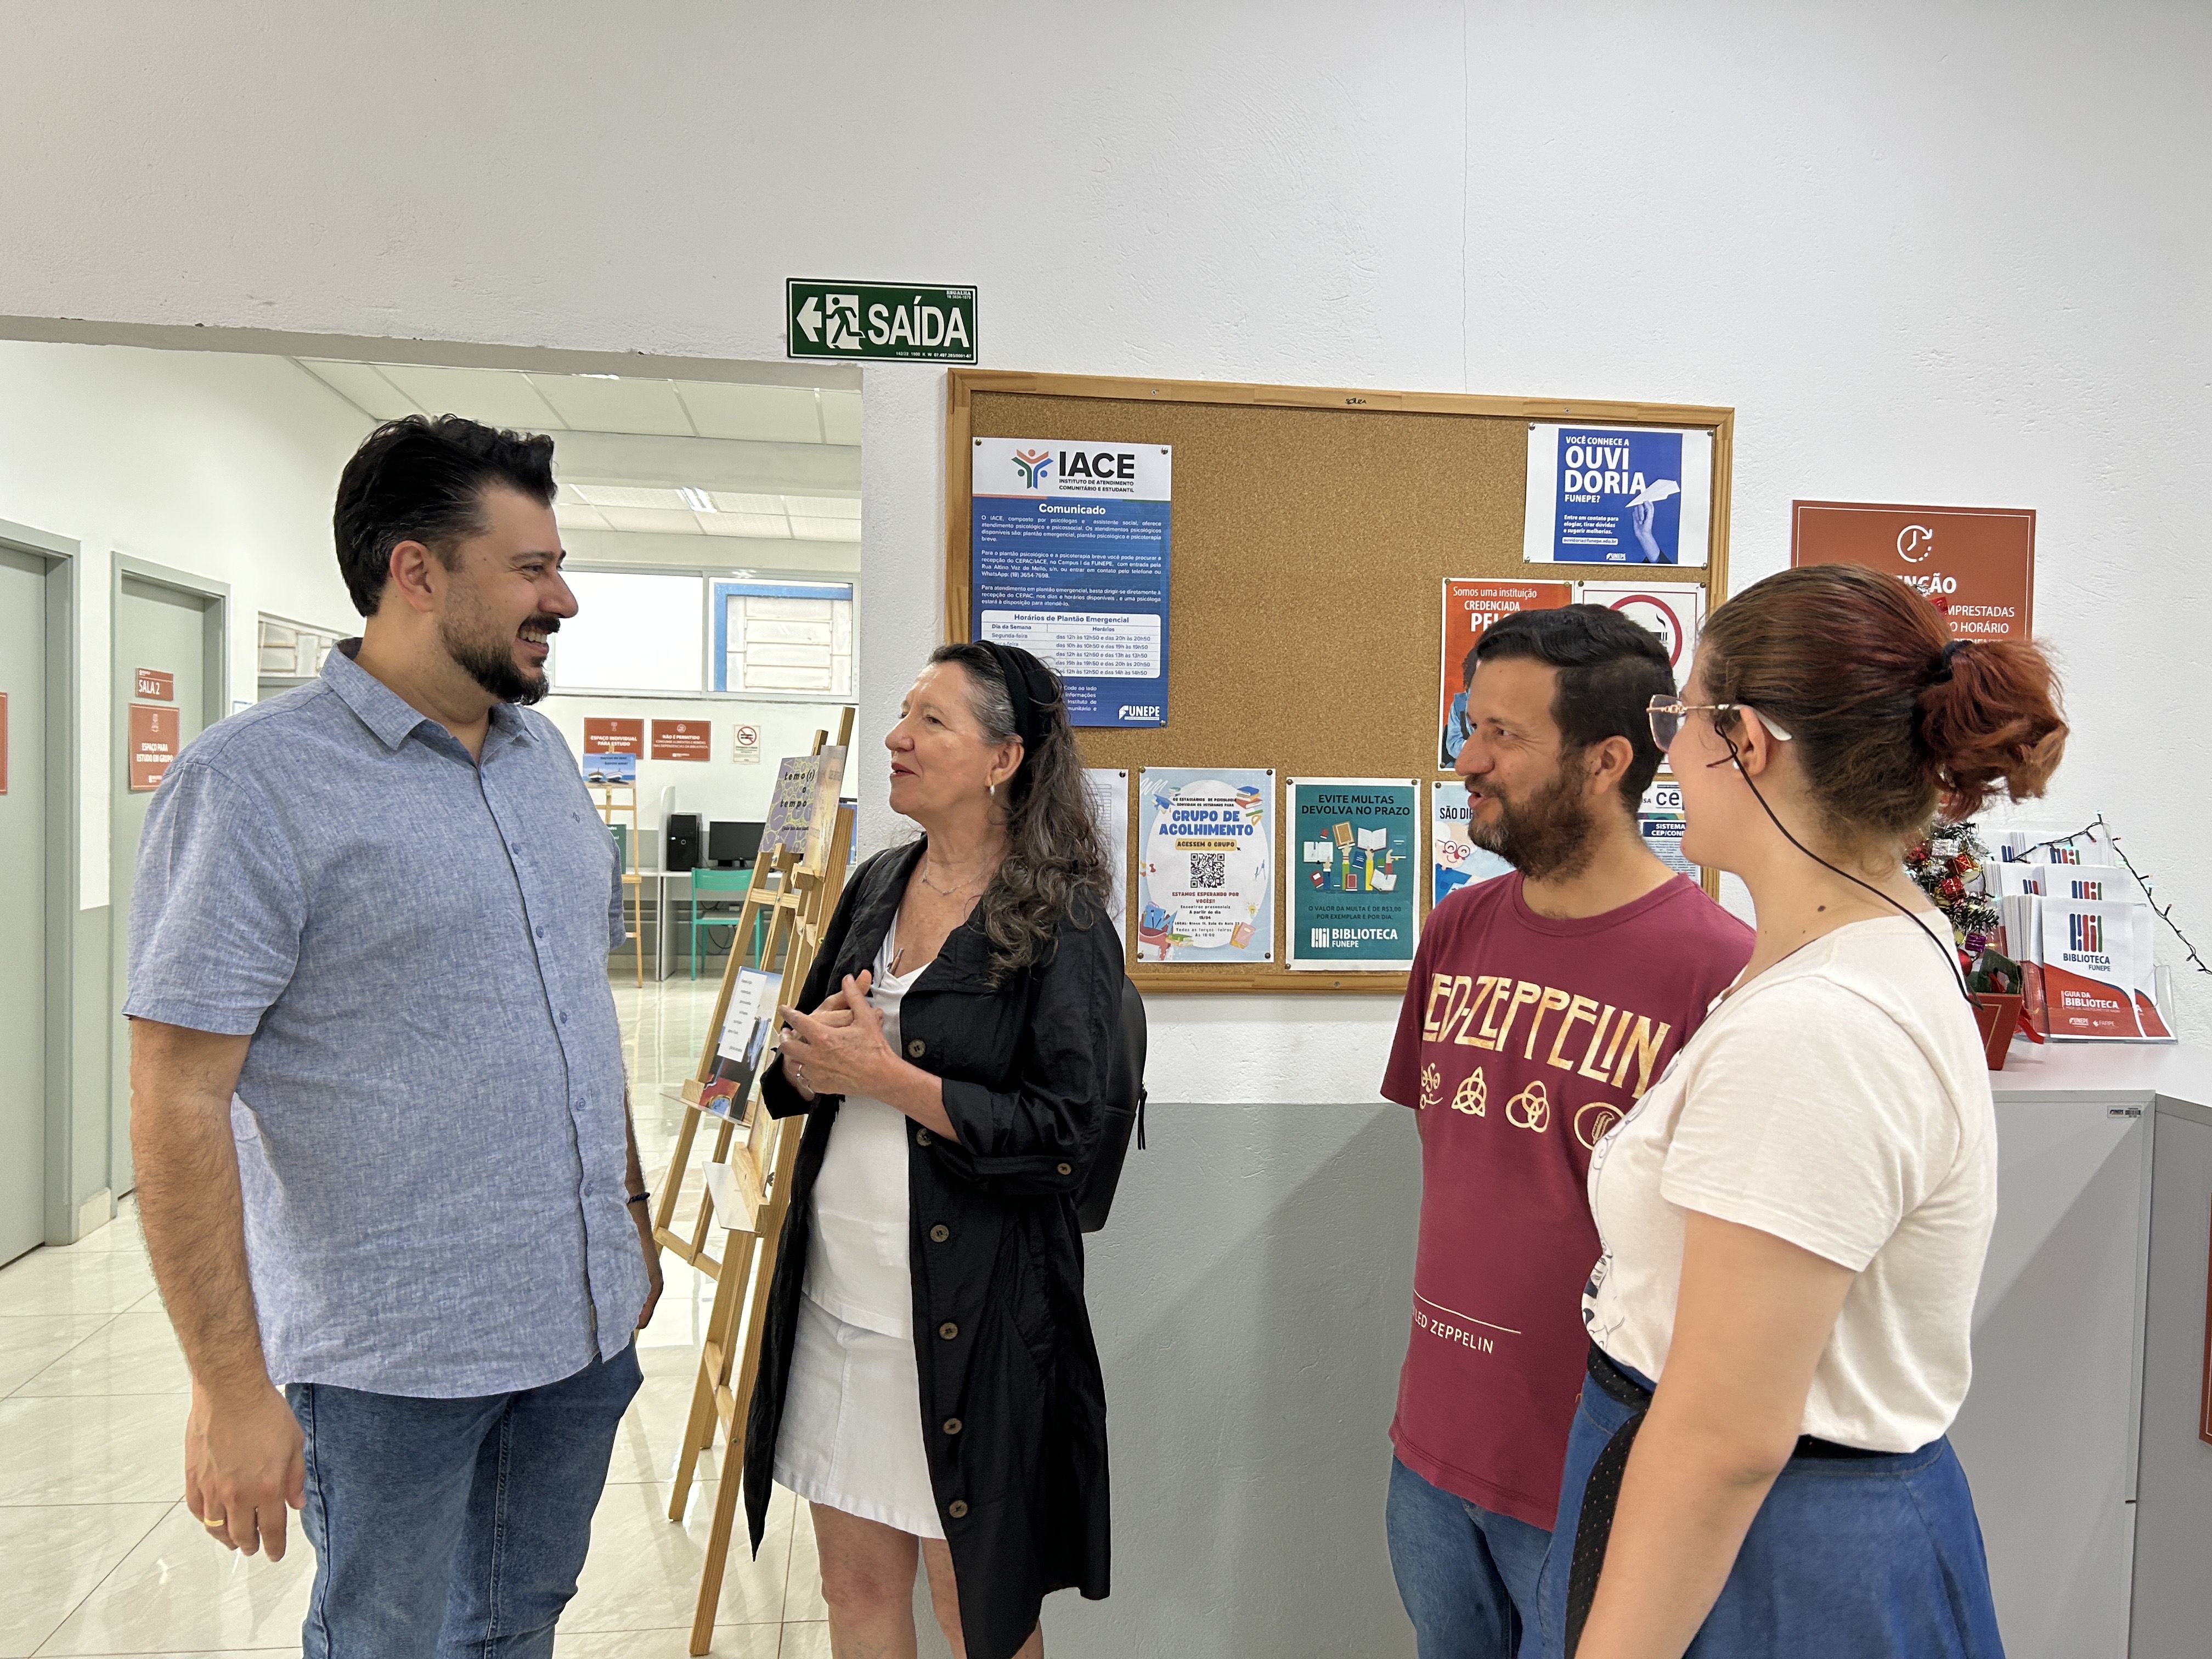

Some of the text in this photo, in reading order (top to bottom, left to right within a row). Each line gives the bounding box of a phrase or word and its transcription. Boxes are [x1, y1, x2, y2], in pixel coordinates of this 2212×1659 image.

[868, 296, 969, 347] SAÍDA
[1566, 435, 1586, 444] VOCÊ
[1587, 437, 1622, 445] CONHECE
[1565, 445, 1629, 470] OUVI
[1059, 451, 1135, 479] IACE
[1564, 470, 1647, 494] DORIA
[1565, 494, 1600, 503] FUNEPE?
[1039, 504, 1106, 515] Comunicado
[1453, 586, 1537, 600] Somos uma instituição
[1464, 600, 1520, 611] CREDENCIADA
[1948, 605, 2015, 618] MPRESTADAS
[1471, 612, 1511, 632] PE
[1949, 620, 2009, 634] O HORÁRIO
[139, 679, 160, 695] SALA 2
[1119, 706, 1160, 719] FUNEPE
[142, 742, 168, 753] ESPAÇO PARA
[136, 754, 153, 762] ESTUDO
[159, 754, 173, 763] GRUPO
[780, 799, 807, 809] tempo
[1318, 794, 1394, 804] EVITE MULTAS
[1172, 810, 1240, 822] GRUPO DE
[1302, 805, 1410, 816] DEVOLVA NO PRAZO
[1440, 805, 1457, 819] SÃO
[1159, 823, 1254, 836] ACOLHIMENTO
[1331, 928, 1398, 940] BIBLIOTECA
[2063, 953, 2111, 964] BIBLIOTECA
[2065, 997, 2119, 1009] BIBLIOTECA
[1415, 1308, 1493, 1354] LED ZEPPELIN
